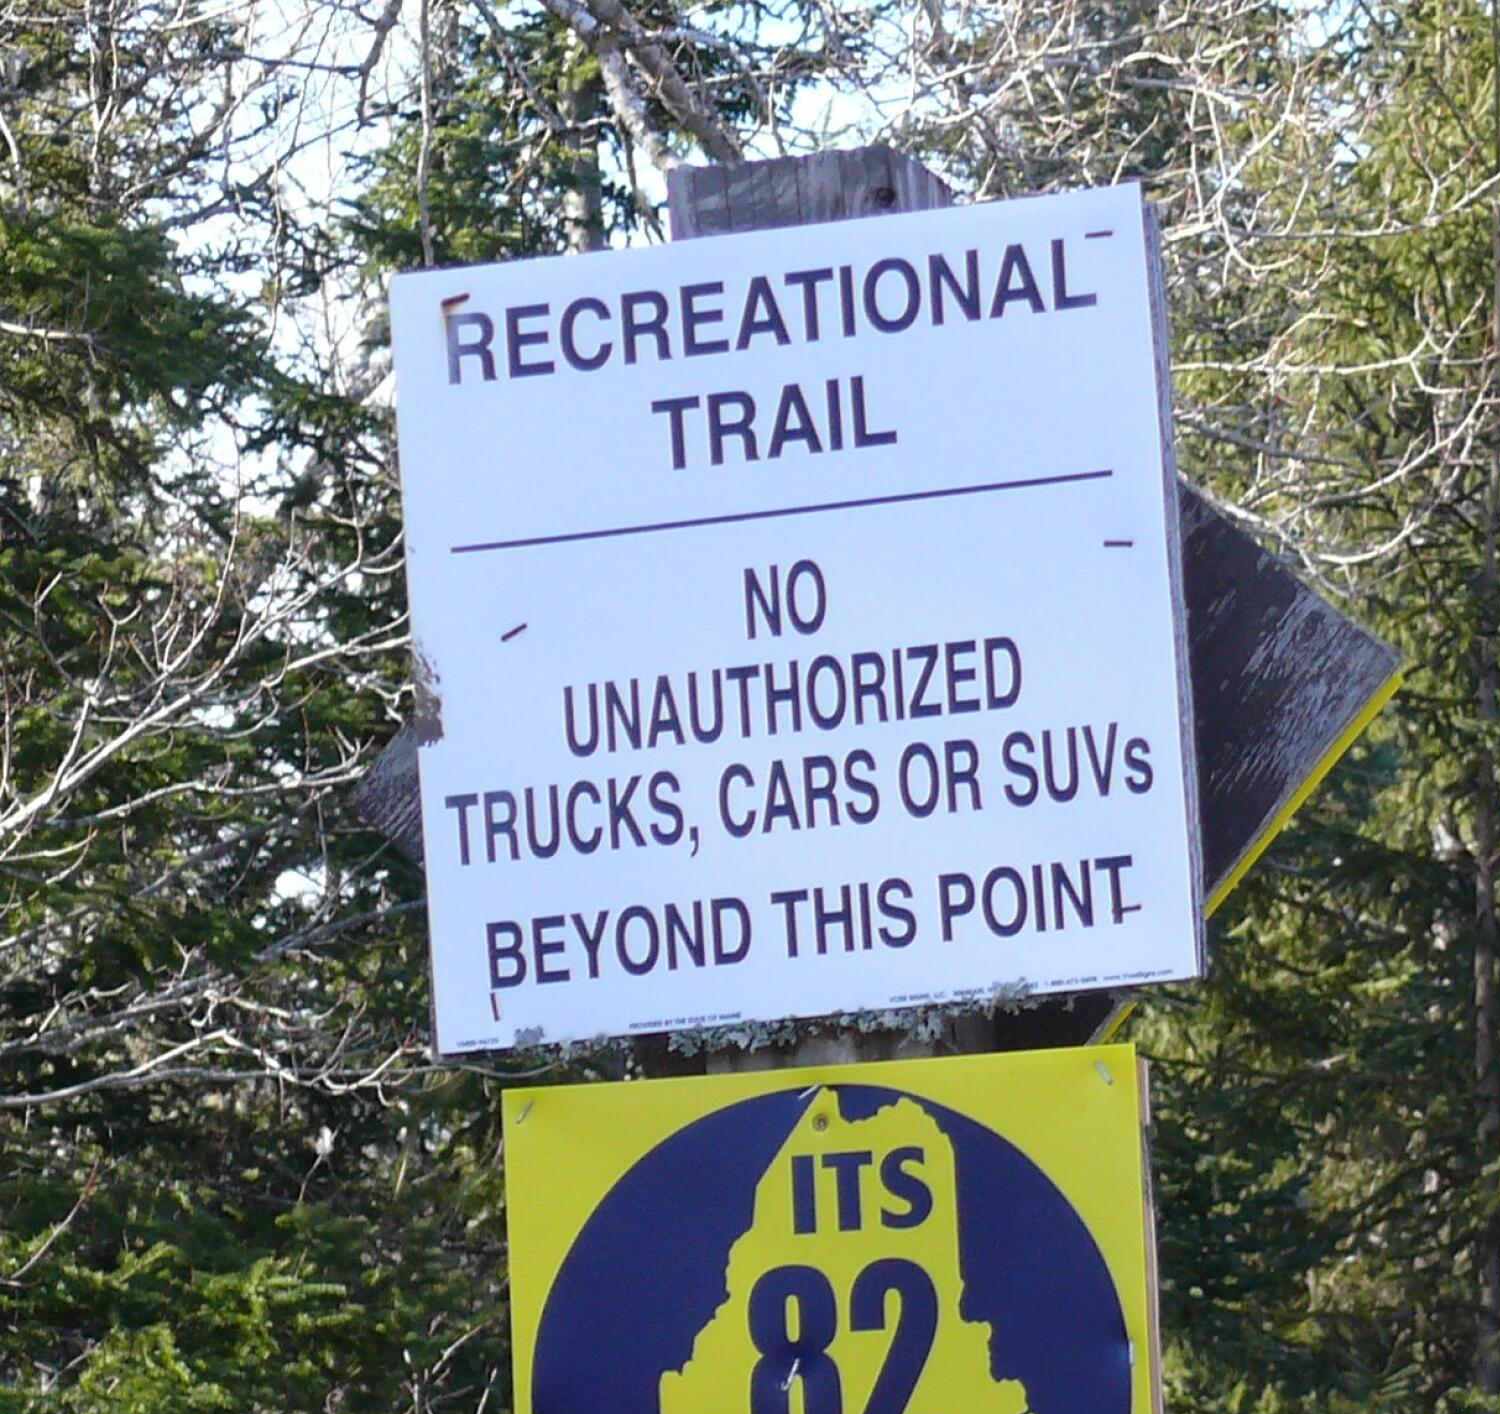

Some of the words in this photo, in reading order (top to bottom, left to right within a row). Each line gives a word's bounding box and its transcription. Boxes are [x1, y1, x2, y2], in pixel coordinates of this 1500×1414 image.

[447, 239, 1097, 385] RECREATIONAL
[651, 375, 898, 471] TRAIL
[743, 559, 827, 640] NO
[563, 636, 1022, 758] UNAUTHORIZED
[445, 771, 699, 866] TRUCKS,
[719, 748, 880, 839] CARS
[898, 739, 983, 819] OR
[1003, 722, 1154, 808] SUVs
[486, 897, 752, 990] BEYOND
[770, 877, 917, 958] THIS
[938, 854, 1134, 942] POINT
[790, 1146, 933, 1235] ITS
